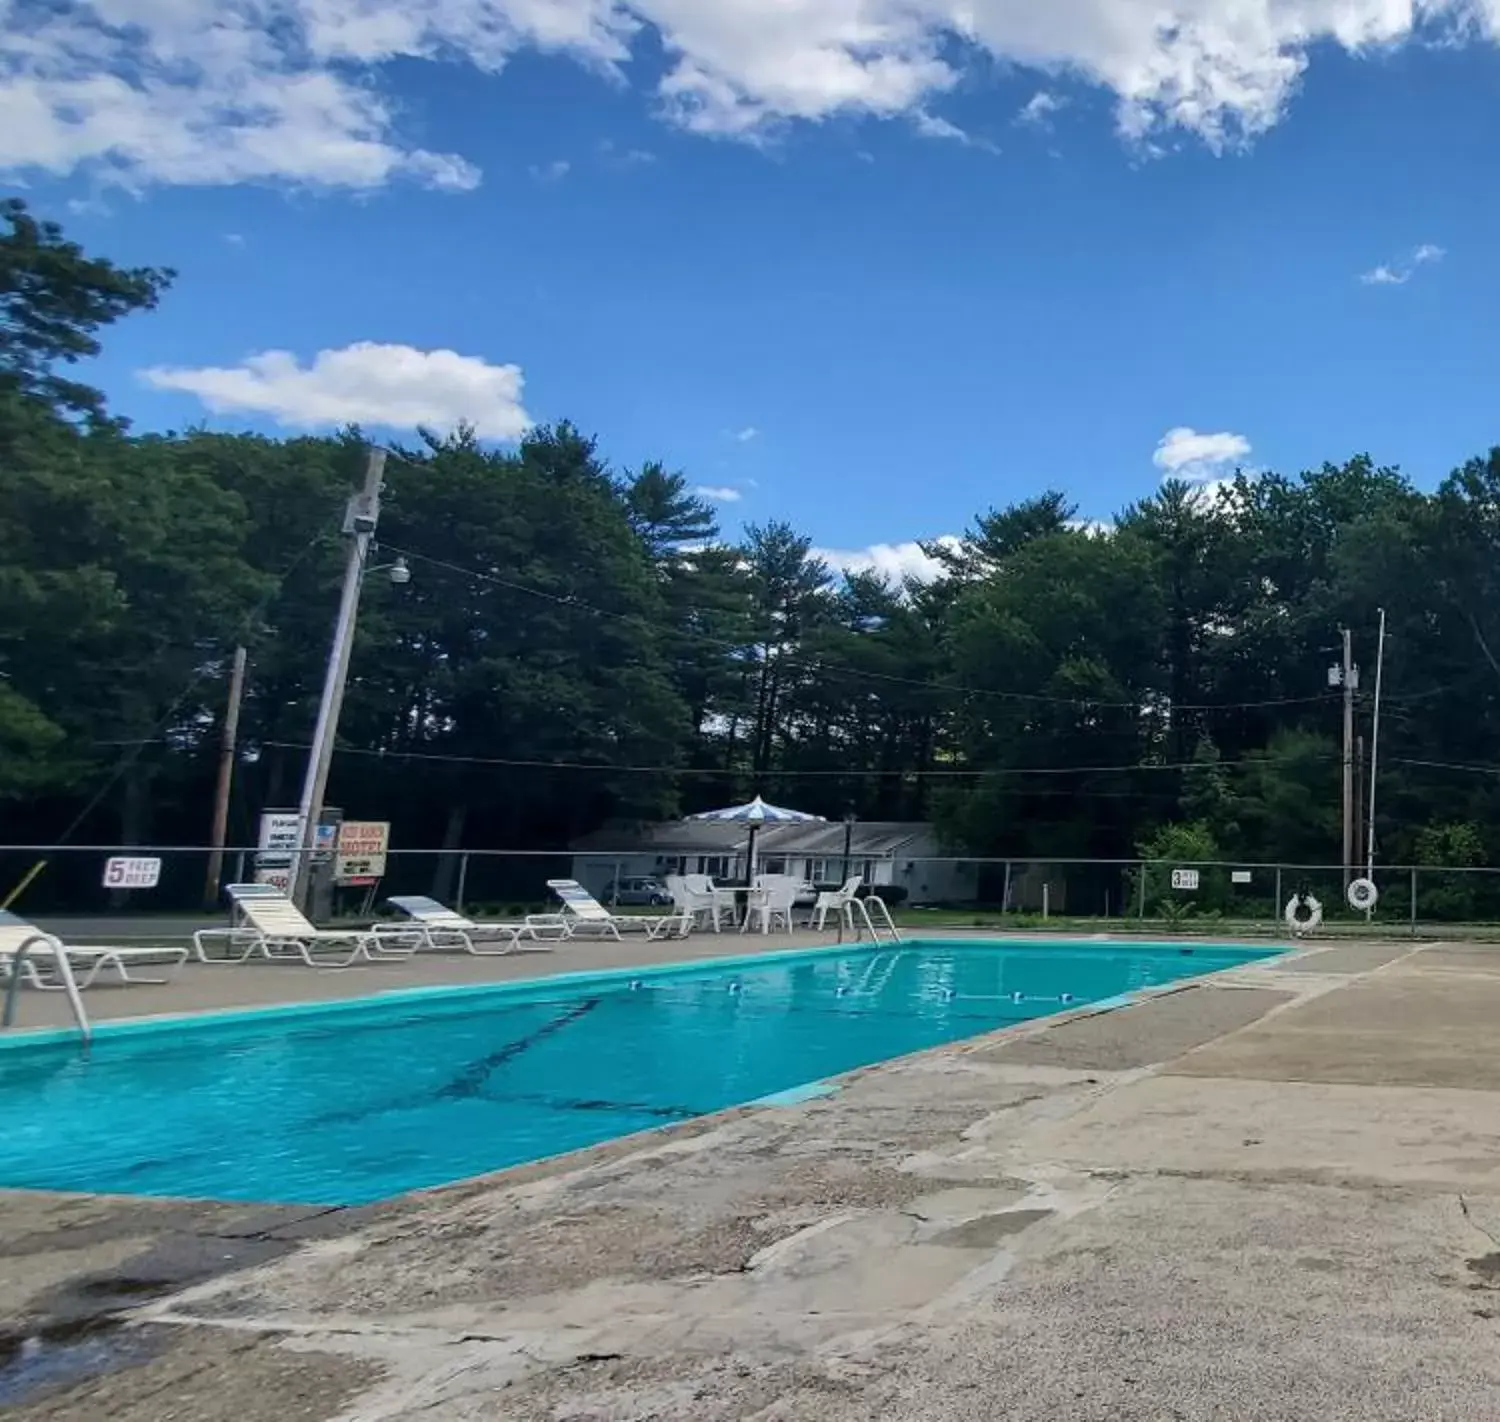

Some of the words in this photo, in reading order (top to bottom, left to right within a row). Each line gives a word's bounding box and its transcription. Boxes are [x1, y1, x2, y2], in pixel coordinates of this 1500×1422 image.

[340, 841, 382, 857] MOTEL
[108, 861, 125, 883] 5
[1174, 872, 1181, 886] 3
